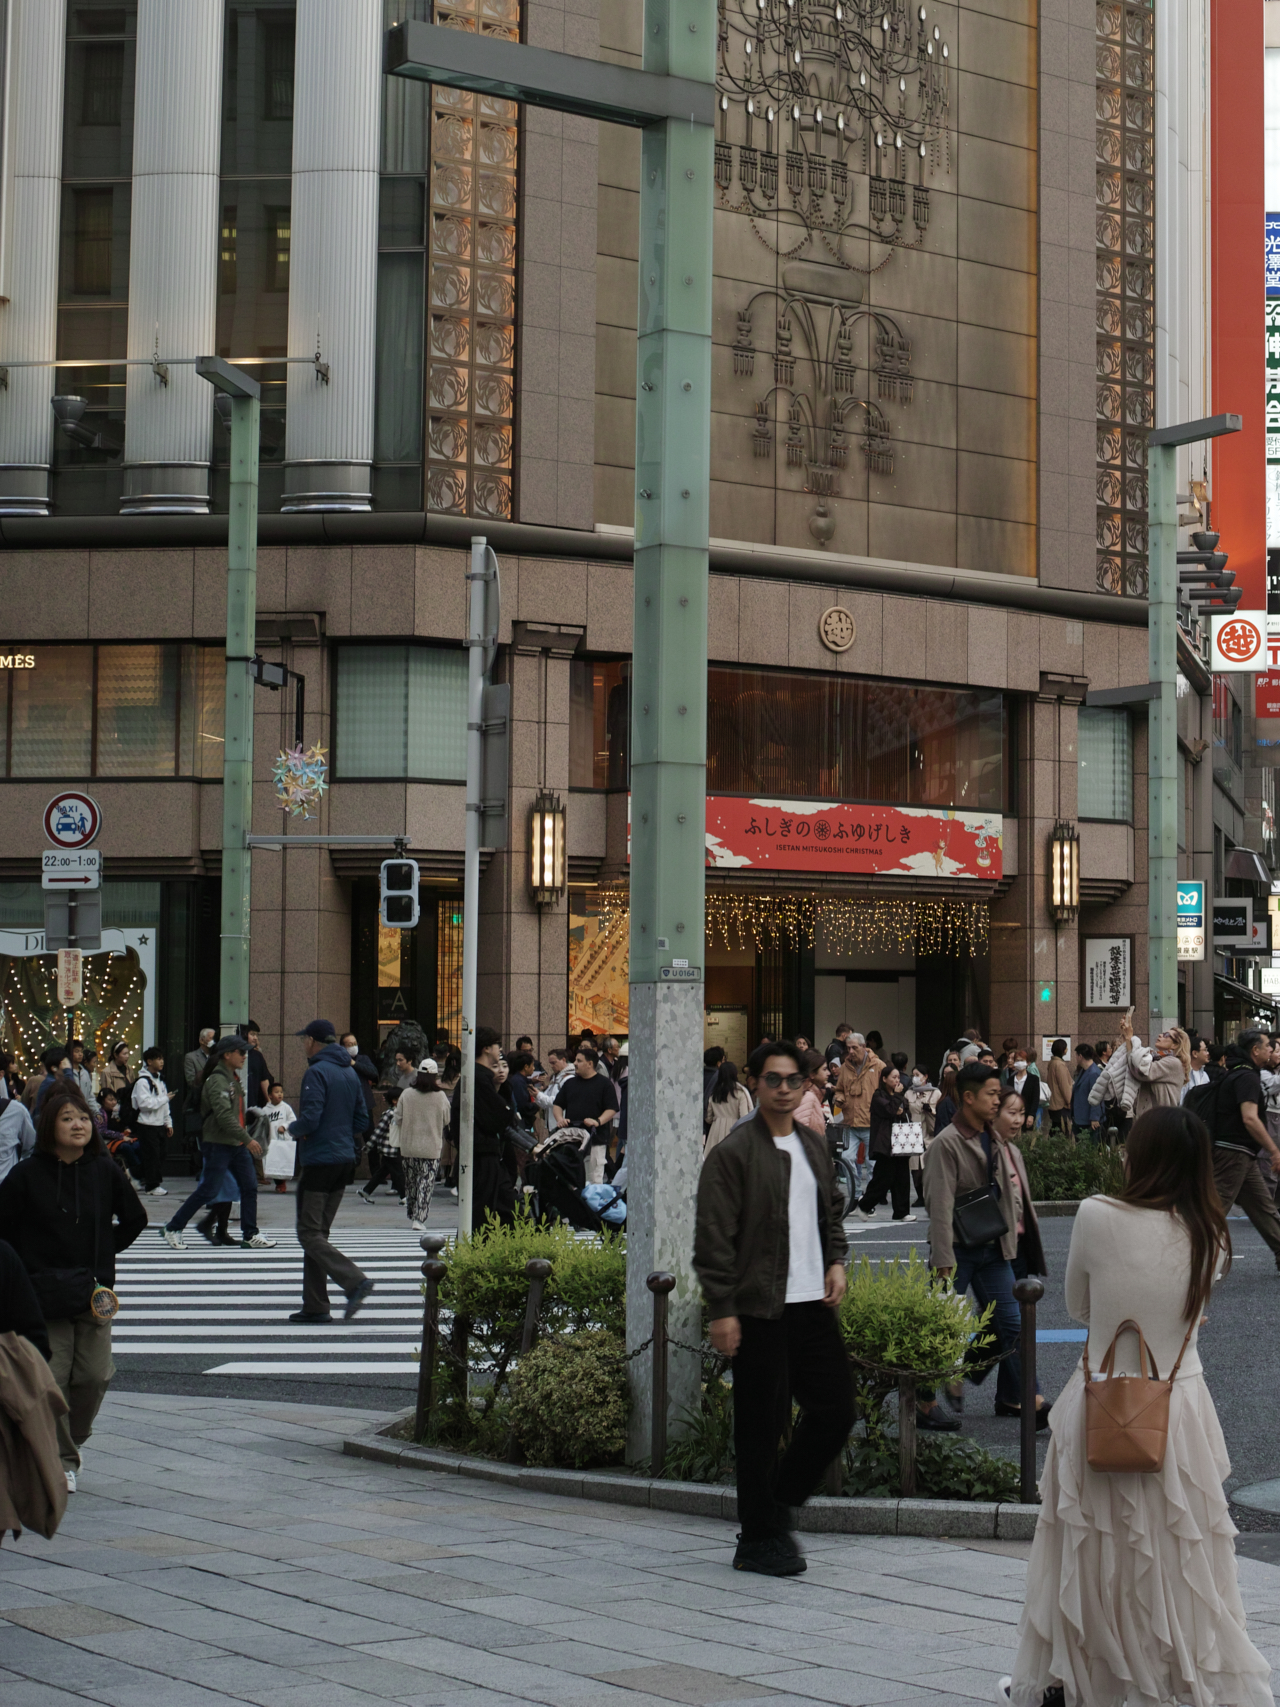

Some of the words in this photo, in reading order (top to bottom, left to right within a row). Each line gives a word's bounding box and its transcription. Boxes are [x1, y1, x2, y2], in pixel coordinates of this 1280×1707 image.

[1267, 447, 1280, 455] 5F
[56, 805, 78, 813] TAXI
[744, 817, 811, 838] ふしぎの
[833, 821, 911, 844] ふゆげしき
[776, 844, 800, 852] ISETAN
[802, 845, 844, 853] MITSUKOSHI
[845, 847, 883, 855] CHRISTMAS
